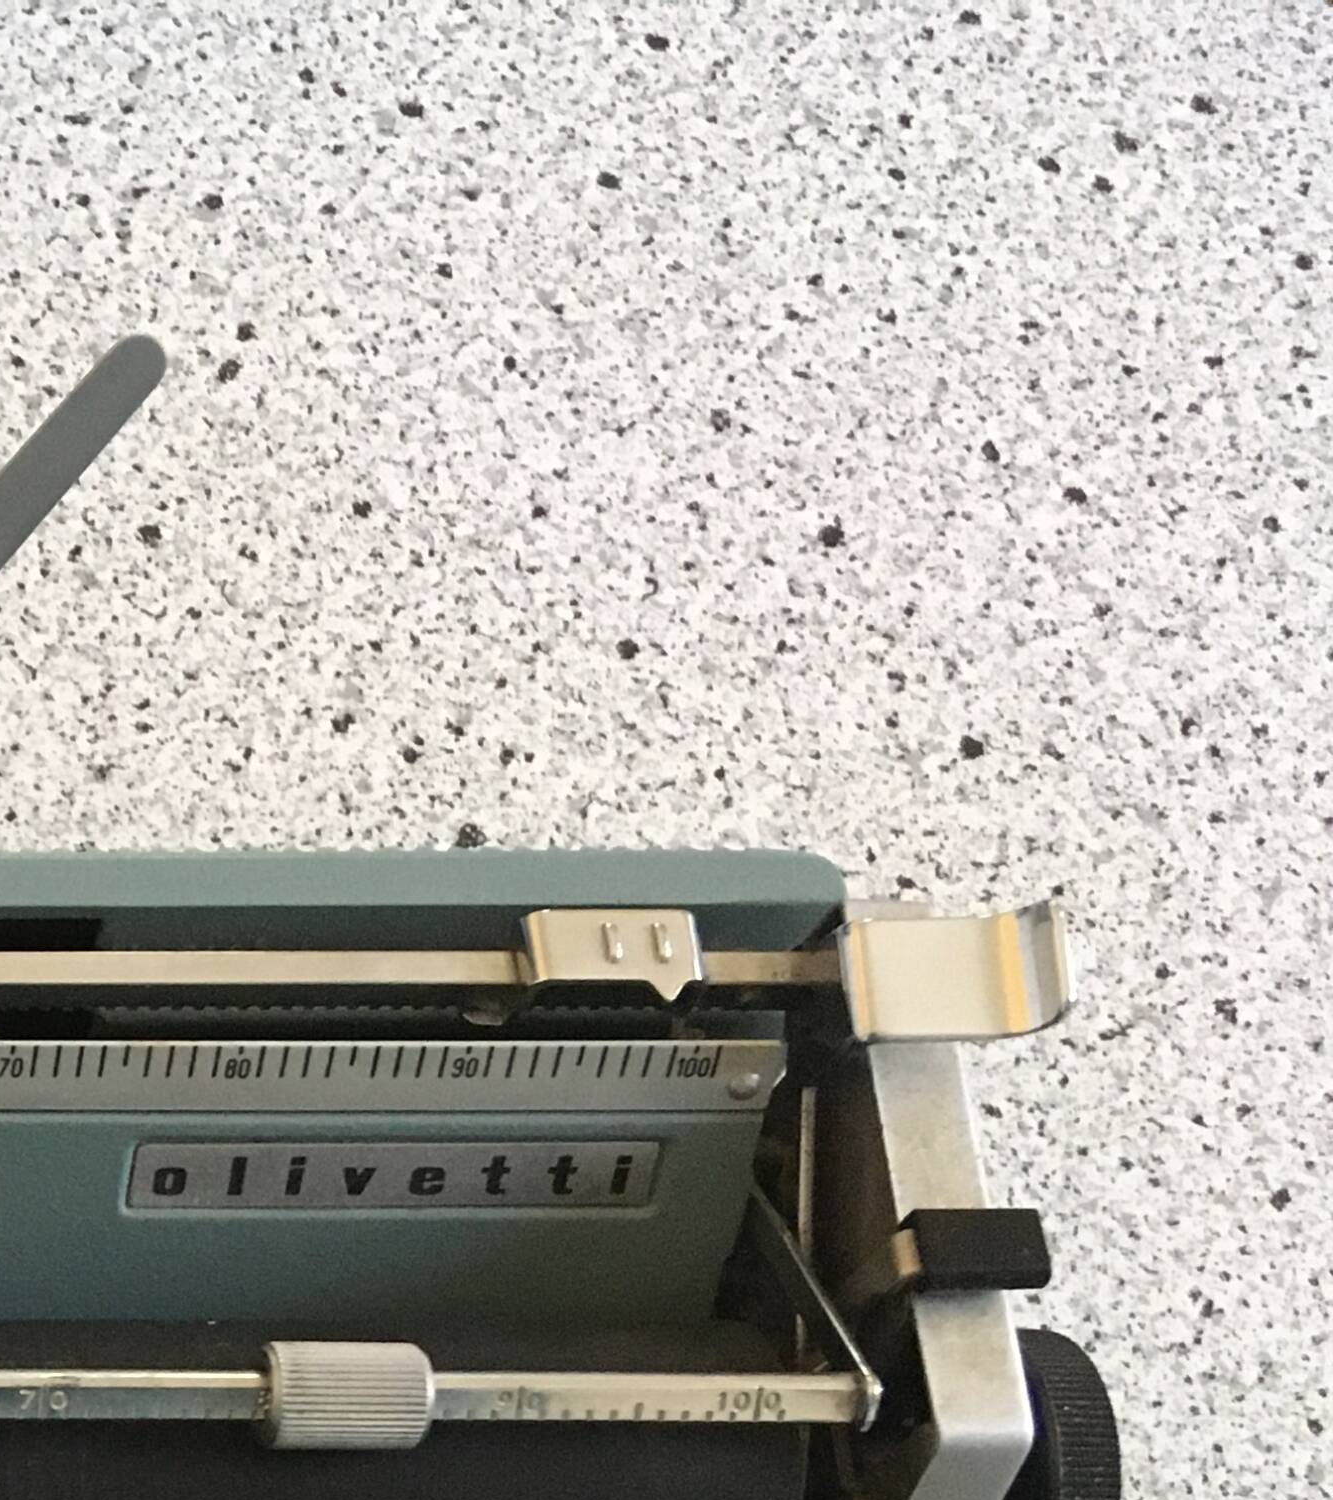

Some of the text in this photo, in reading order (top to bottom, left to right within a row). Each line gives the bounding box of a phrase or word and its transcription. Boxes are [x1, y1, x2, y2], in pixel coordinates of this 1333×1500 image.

[224, 1058, 251, 1080] 80
[451, 1057, 479, 1079] 90
[677, 1057, 710, 1079] 100
[152, 1155, 633, 1197] olivetti
[19, 1390, 69, 1412] 70
